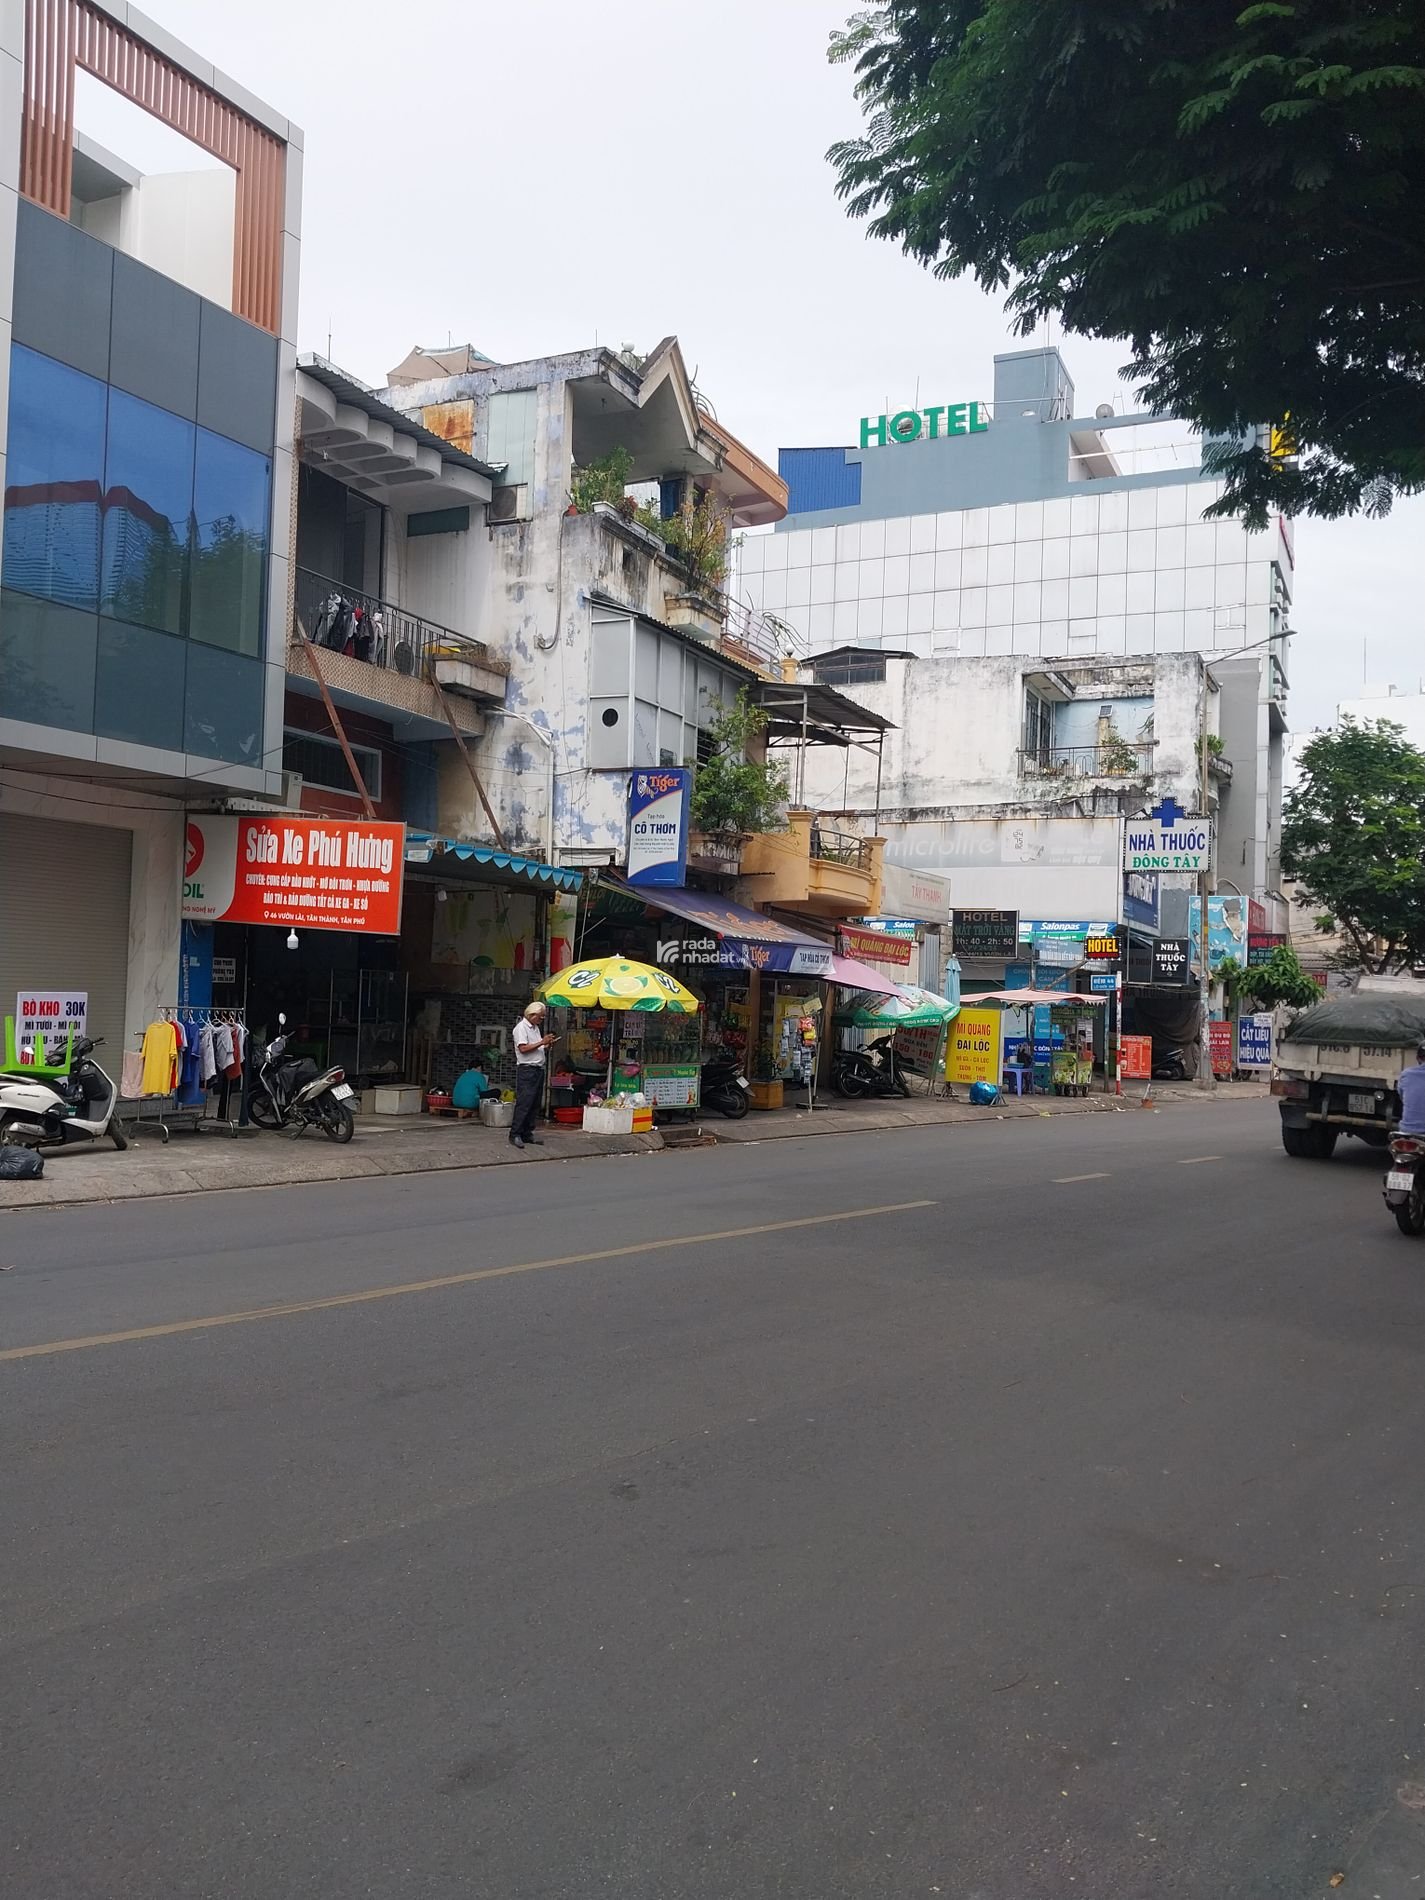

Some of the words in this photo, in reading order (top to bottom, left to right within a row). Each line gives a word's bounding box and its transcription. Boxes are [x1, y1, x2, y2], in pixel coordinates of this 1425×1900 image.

[860, 400, 988, 449] HOTEL
[649, 774, 680, 792] Tiger
[635, 821, 647, 834] CÔ
[650, 821, 676, 834] THƠM
[1129, 828, 1155, 851] NHÀ
[1160, 826, 1205, 850] THUỐC
[246, 825, 279, 863] Sửa
[282, 829, 304, 865] Xe
[308, 830, 342, 867] Phú
[346, 832, 394, 874] Hưng
[1133, 854, 1169, 868] ĐÔNG
[1173, 853, 1200, 868] TÂY
[963, 912, 1008, 922] HOTEL
[1040, 922, 1080, 931] Salonpas
[1088, 938, 1118, 953] HOTEL
[1160, 942, 1180, 951] NHÀ
[751, 946, 770, 967] Tiger
[1155, 951, 1186, 962] THUỐC
[1160, 963, 1179, 971] TÂY
[568, 970, 600, 988] C2
[23, 999, 36, 1016] BÒ
[39, 1001, 60, 1016] KHO
[66, 1001, 85, 1016] 30K
[25, 1020, 34, 1030] MÌ
[58, 1020, 67, 1030] MÌ
[957, 1040, 971, 1052] ĐẠI
[974, 1039, 990, 1053] LỘC
[1240, 1044, 1254, 1062] HIỆU
[1256, 1043, 1270, 1062] QUẢ
